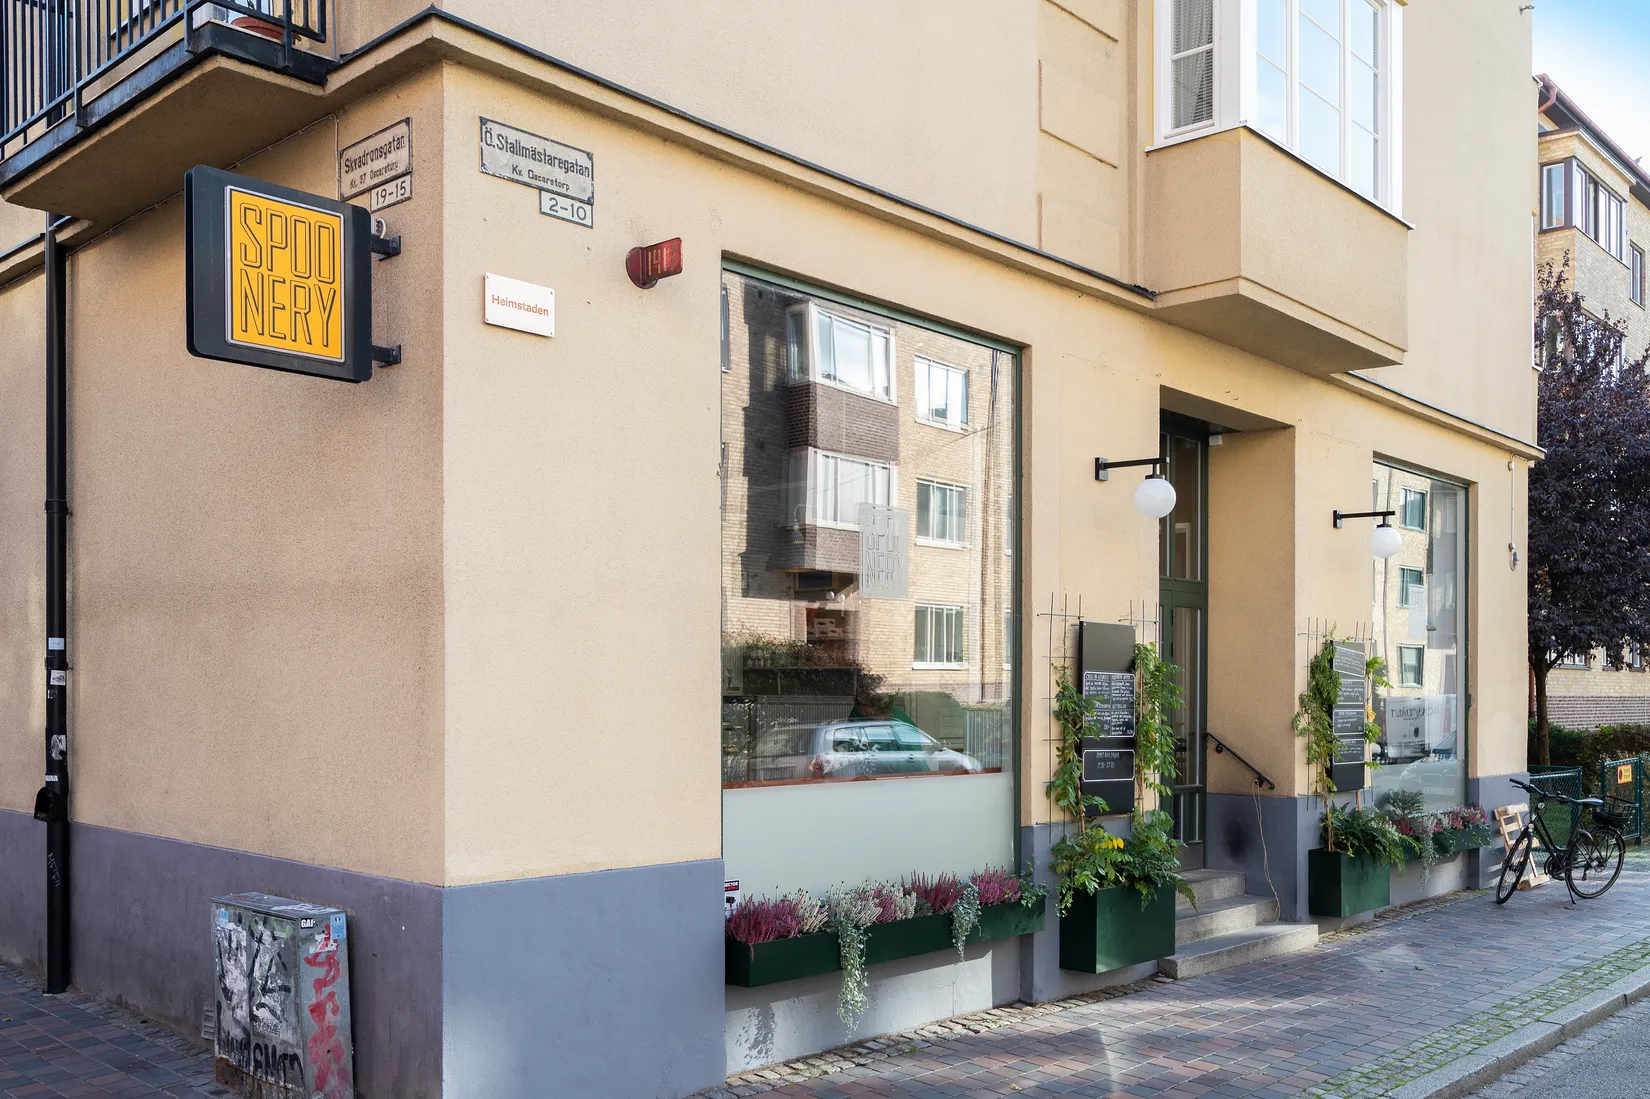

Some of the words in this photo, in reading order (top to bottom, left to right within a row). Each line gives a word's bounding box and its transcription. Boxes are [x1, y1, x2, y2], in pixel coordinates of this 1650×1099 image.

[345, 135, 406, 174] Skvadronsgatan
[512, 164, 523, 177] Kv.
[528, 169, 570, 191] Oscarstorp
[375, 180, 407, 205] 19-15
[548, 197, 587, 221] 2-10
[239, 201, 335, 285] SPOO
[240, 268, 337, 348] NERY
[491, 294, 549, 316] Heimstaden
